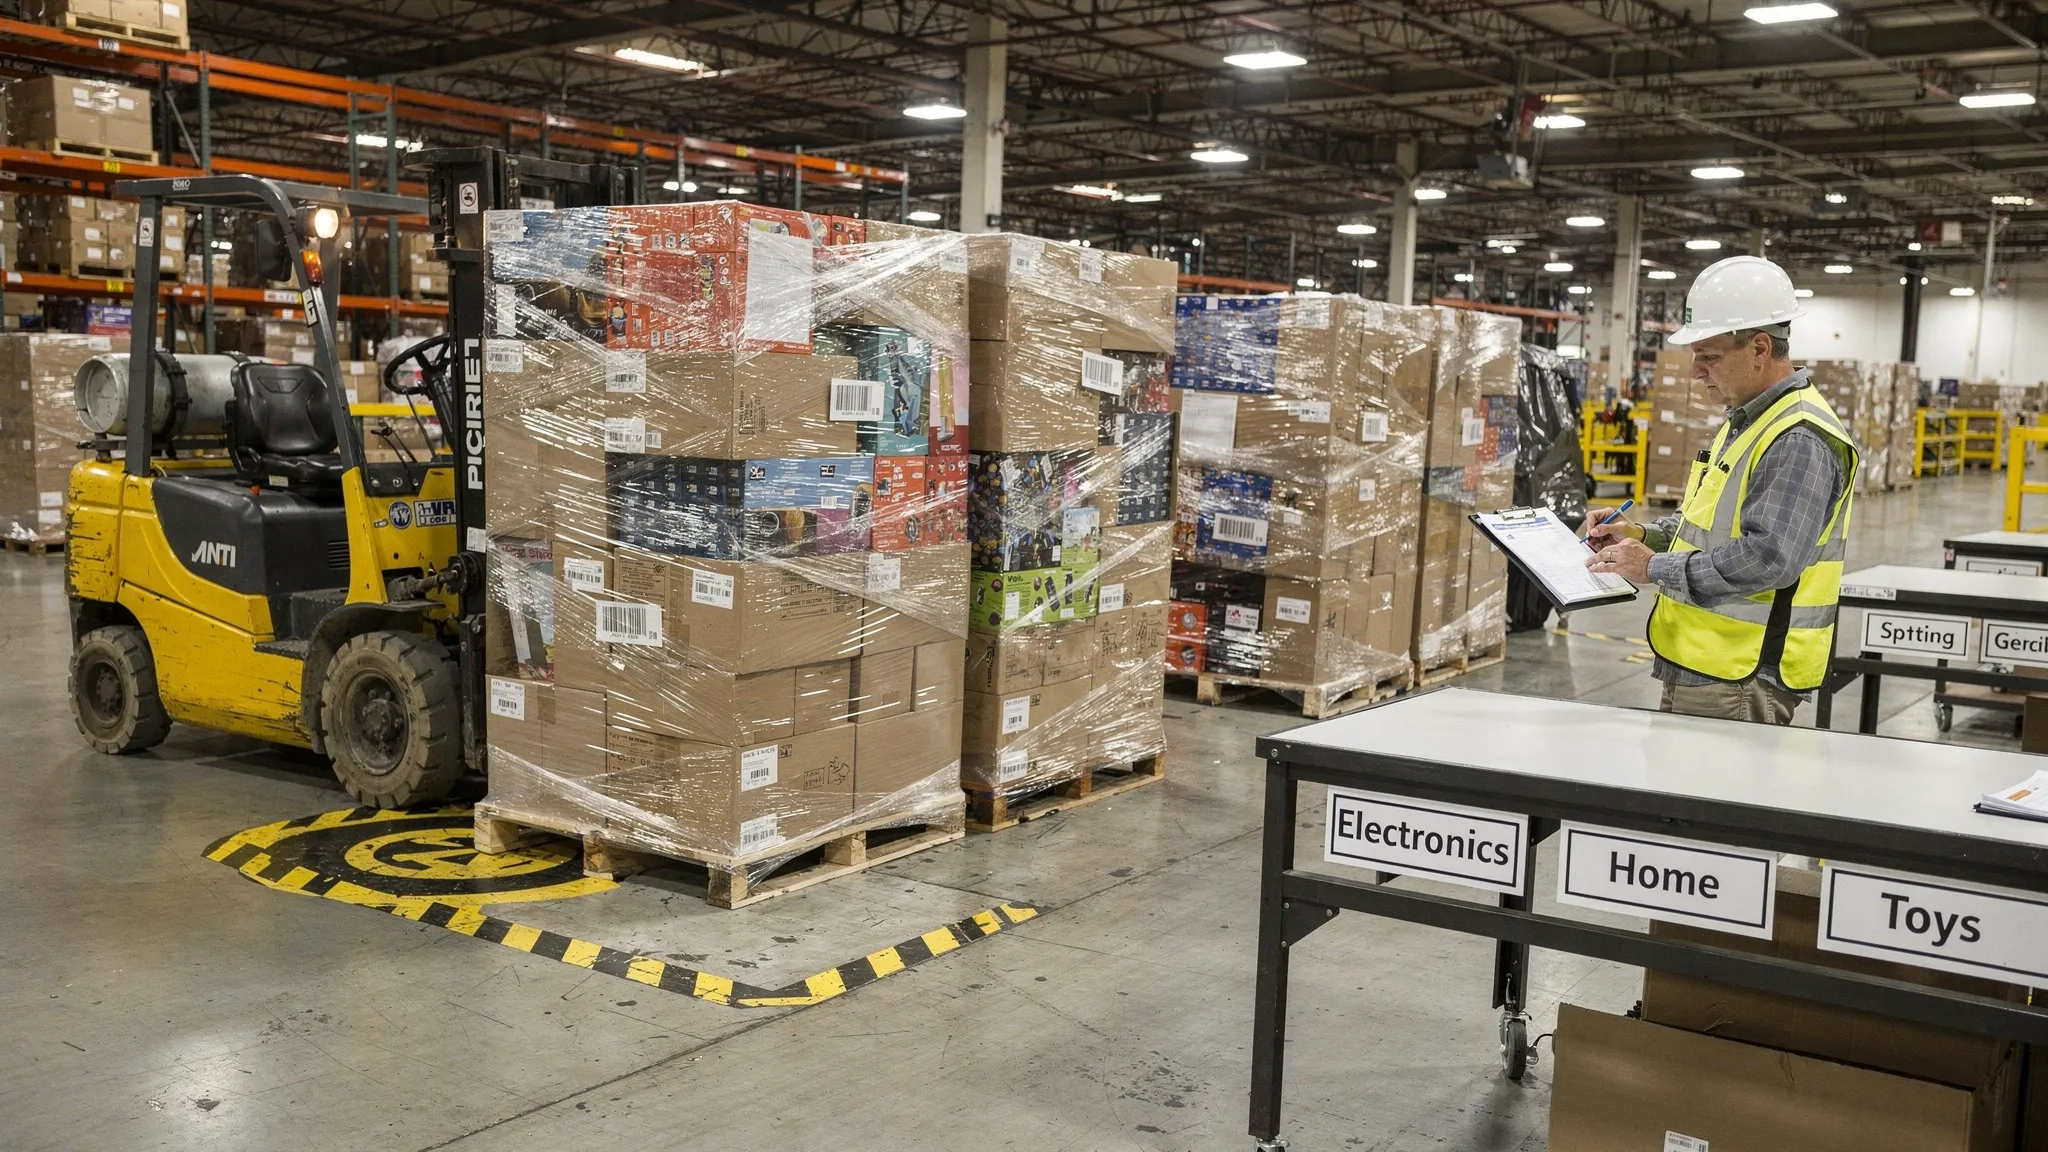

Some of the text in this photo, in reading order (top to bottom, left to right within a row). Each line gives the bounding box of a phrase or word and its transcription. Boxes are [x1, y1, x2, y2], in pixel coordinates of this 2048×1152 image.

[191, 540, 236, 568] ANTI
[1880, 621, 1955, 650] Sptting
[1338, 808, 1509, 865] Electronics
[1610, 851, 1720, 900] Home
[1881, 892, 1981, 948] Toys
